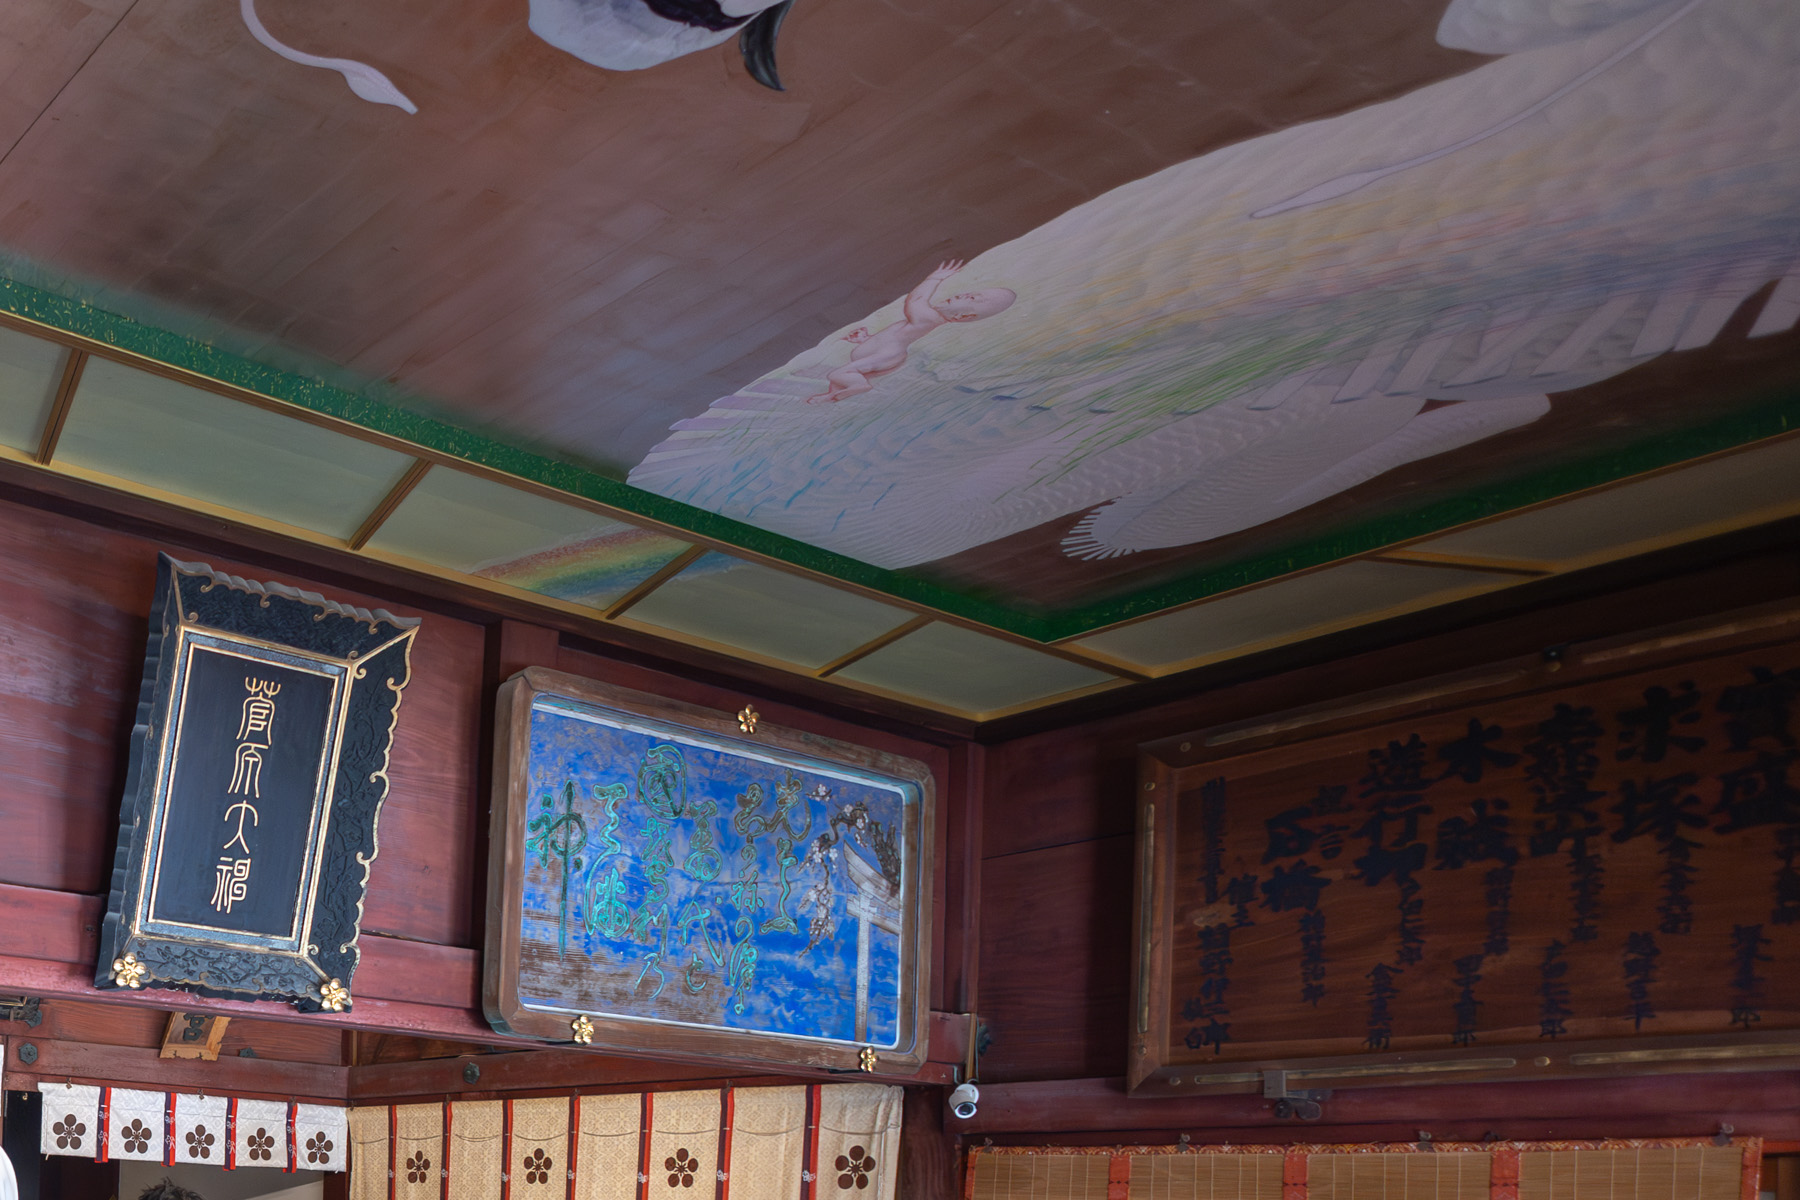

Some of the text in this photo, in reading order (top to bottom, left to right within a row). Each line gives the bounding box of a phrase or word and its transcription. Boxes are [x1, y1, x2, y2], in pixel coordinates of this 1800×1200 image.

[210, 676, 282, 915] 菅原大神
[1611, 682, 1708, 842] 求塚
